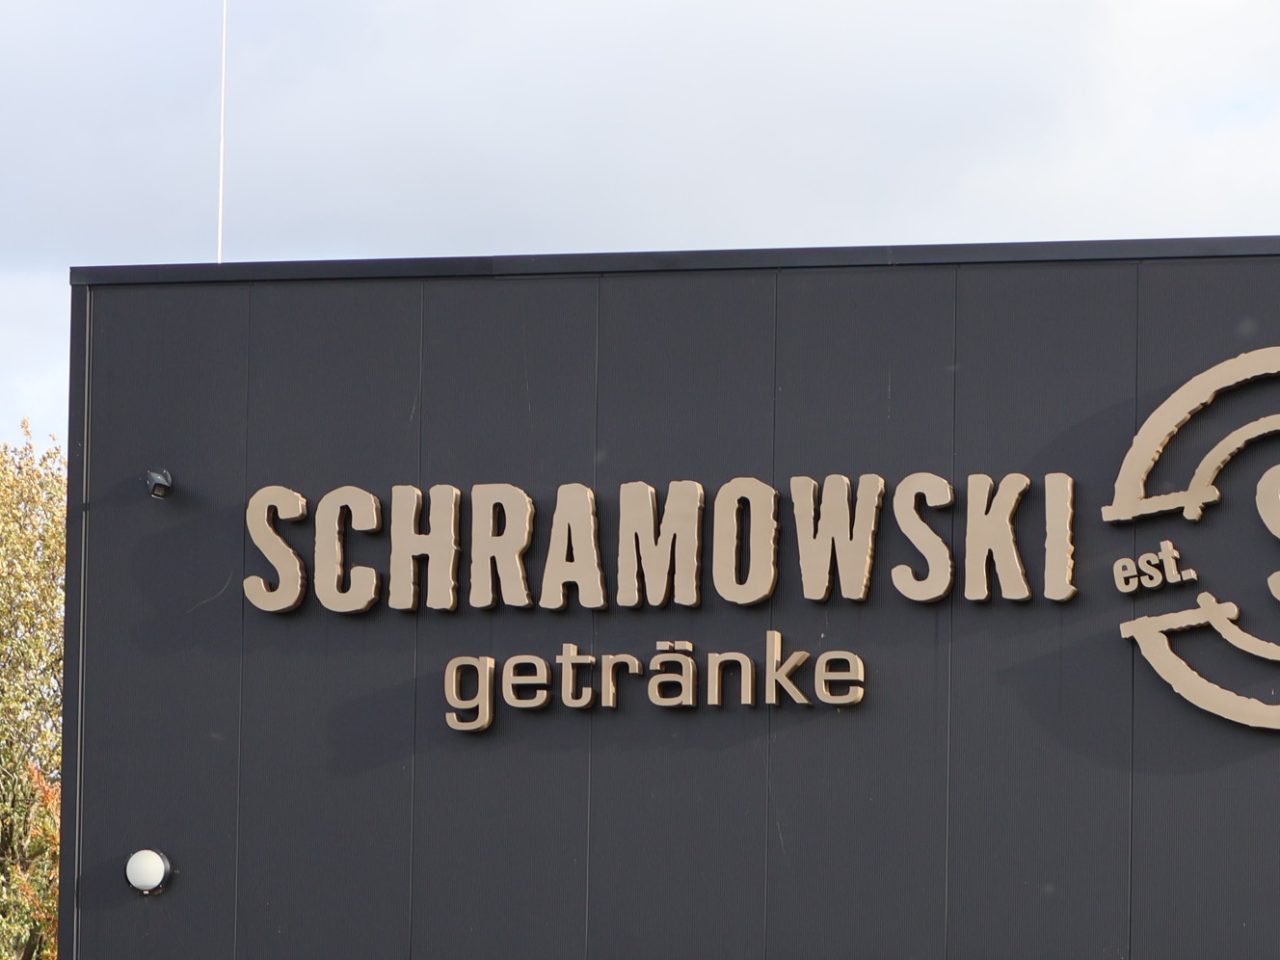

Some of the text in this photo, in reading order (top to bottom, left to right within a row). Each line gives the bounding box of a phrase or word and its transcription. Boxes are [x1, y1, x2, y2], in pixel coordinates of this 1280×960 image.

[242, 471, 1078, 614] SCHRAMOWSKI
[1111, 539, 1199, 594] est.
[443, 630, 866, 733] getränke
